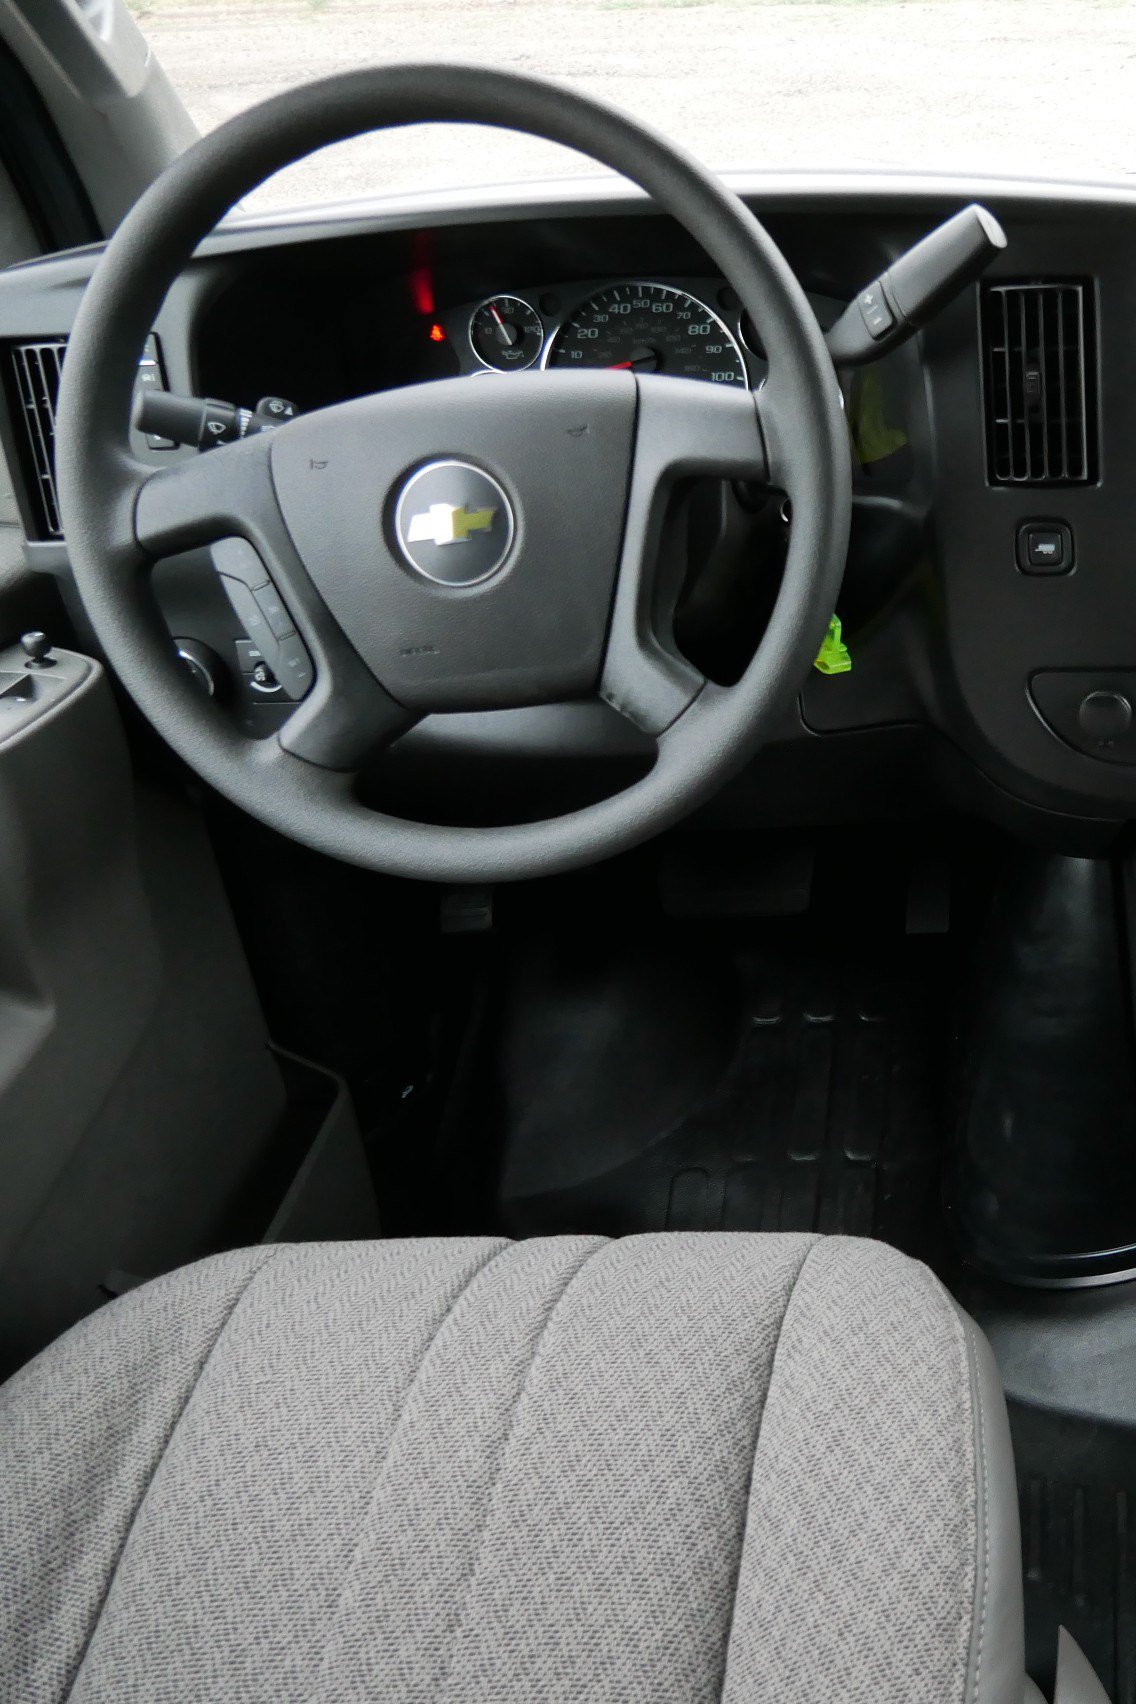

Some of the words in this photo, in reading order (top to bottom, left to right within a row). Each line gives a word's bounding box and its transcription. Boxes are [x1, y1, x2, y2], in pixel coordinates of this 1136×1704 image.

[608, 303, 631, 314] 40
[632, 299, 651, 309] 50
[651, 302, 674, 314] 60
[593, 313, 609, 324] 30
[676, 311, 692, 320] 70
[577, 328, 600, 339] 20
[687, 324, 711, 336] 80
[570, 350, 583, 360] 10
[704, 345, 722, 354] 90
[710, 371, 735, 382] 100
